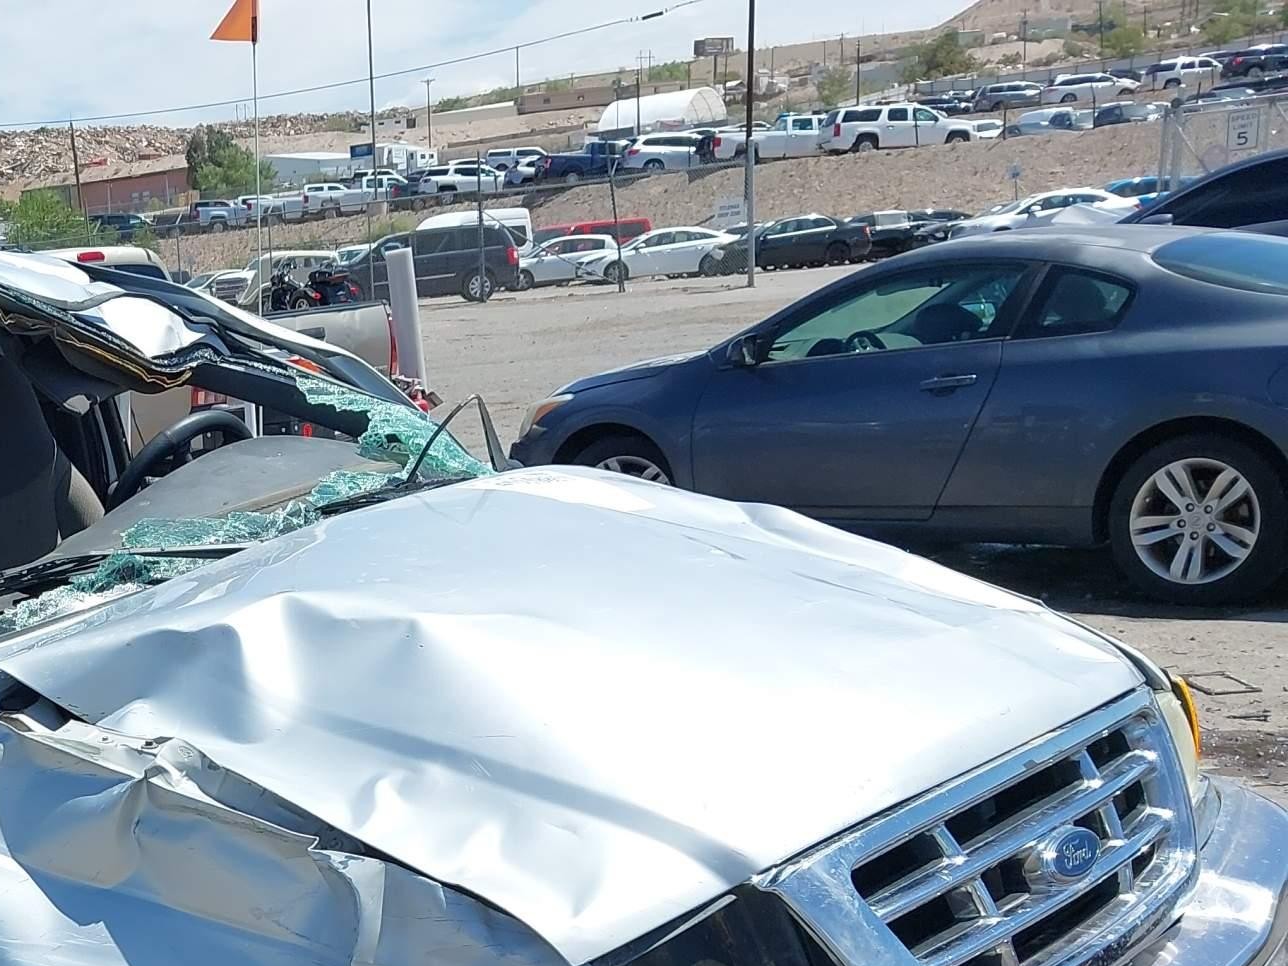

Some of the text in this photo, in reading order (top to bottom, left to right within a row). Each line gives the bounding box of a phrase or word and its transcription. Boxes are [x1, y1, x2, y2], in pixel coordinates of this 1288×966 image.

[1231, 112, 1257, 122] SPEED
[1232, 121, 1254, 131] LIMIT
[1236, 131, 1249, 146] 5
[1062, 838, 1092, 871] Ford
